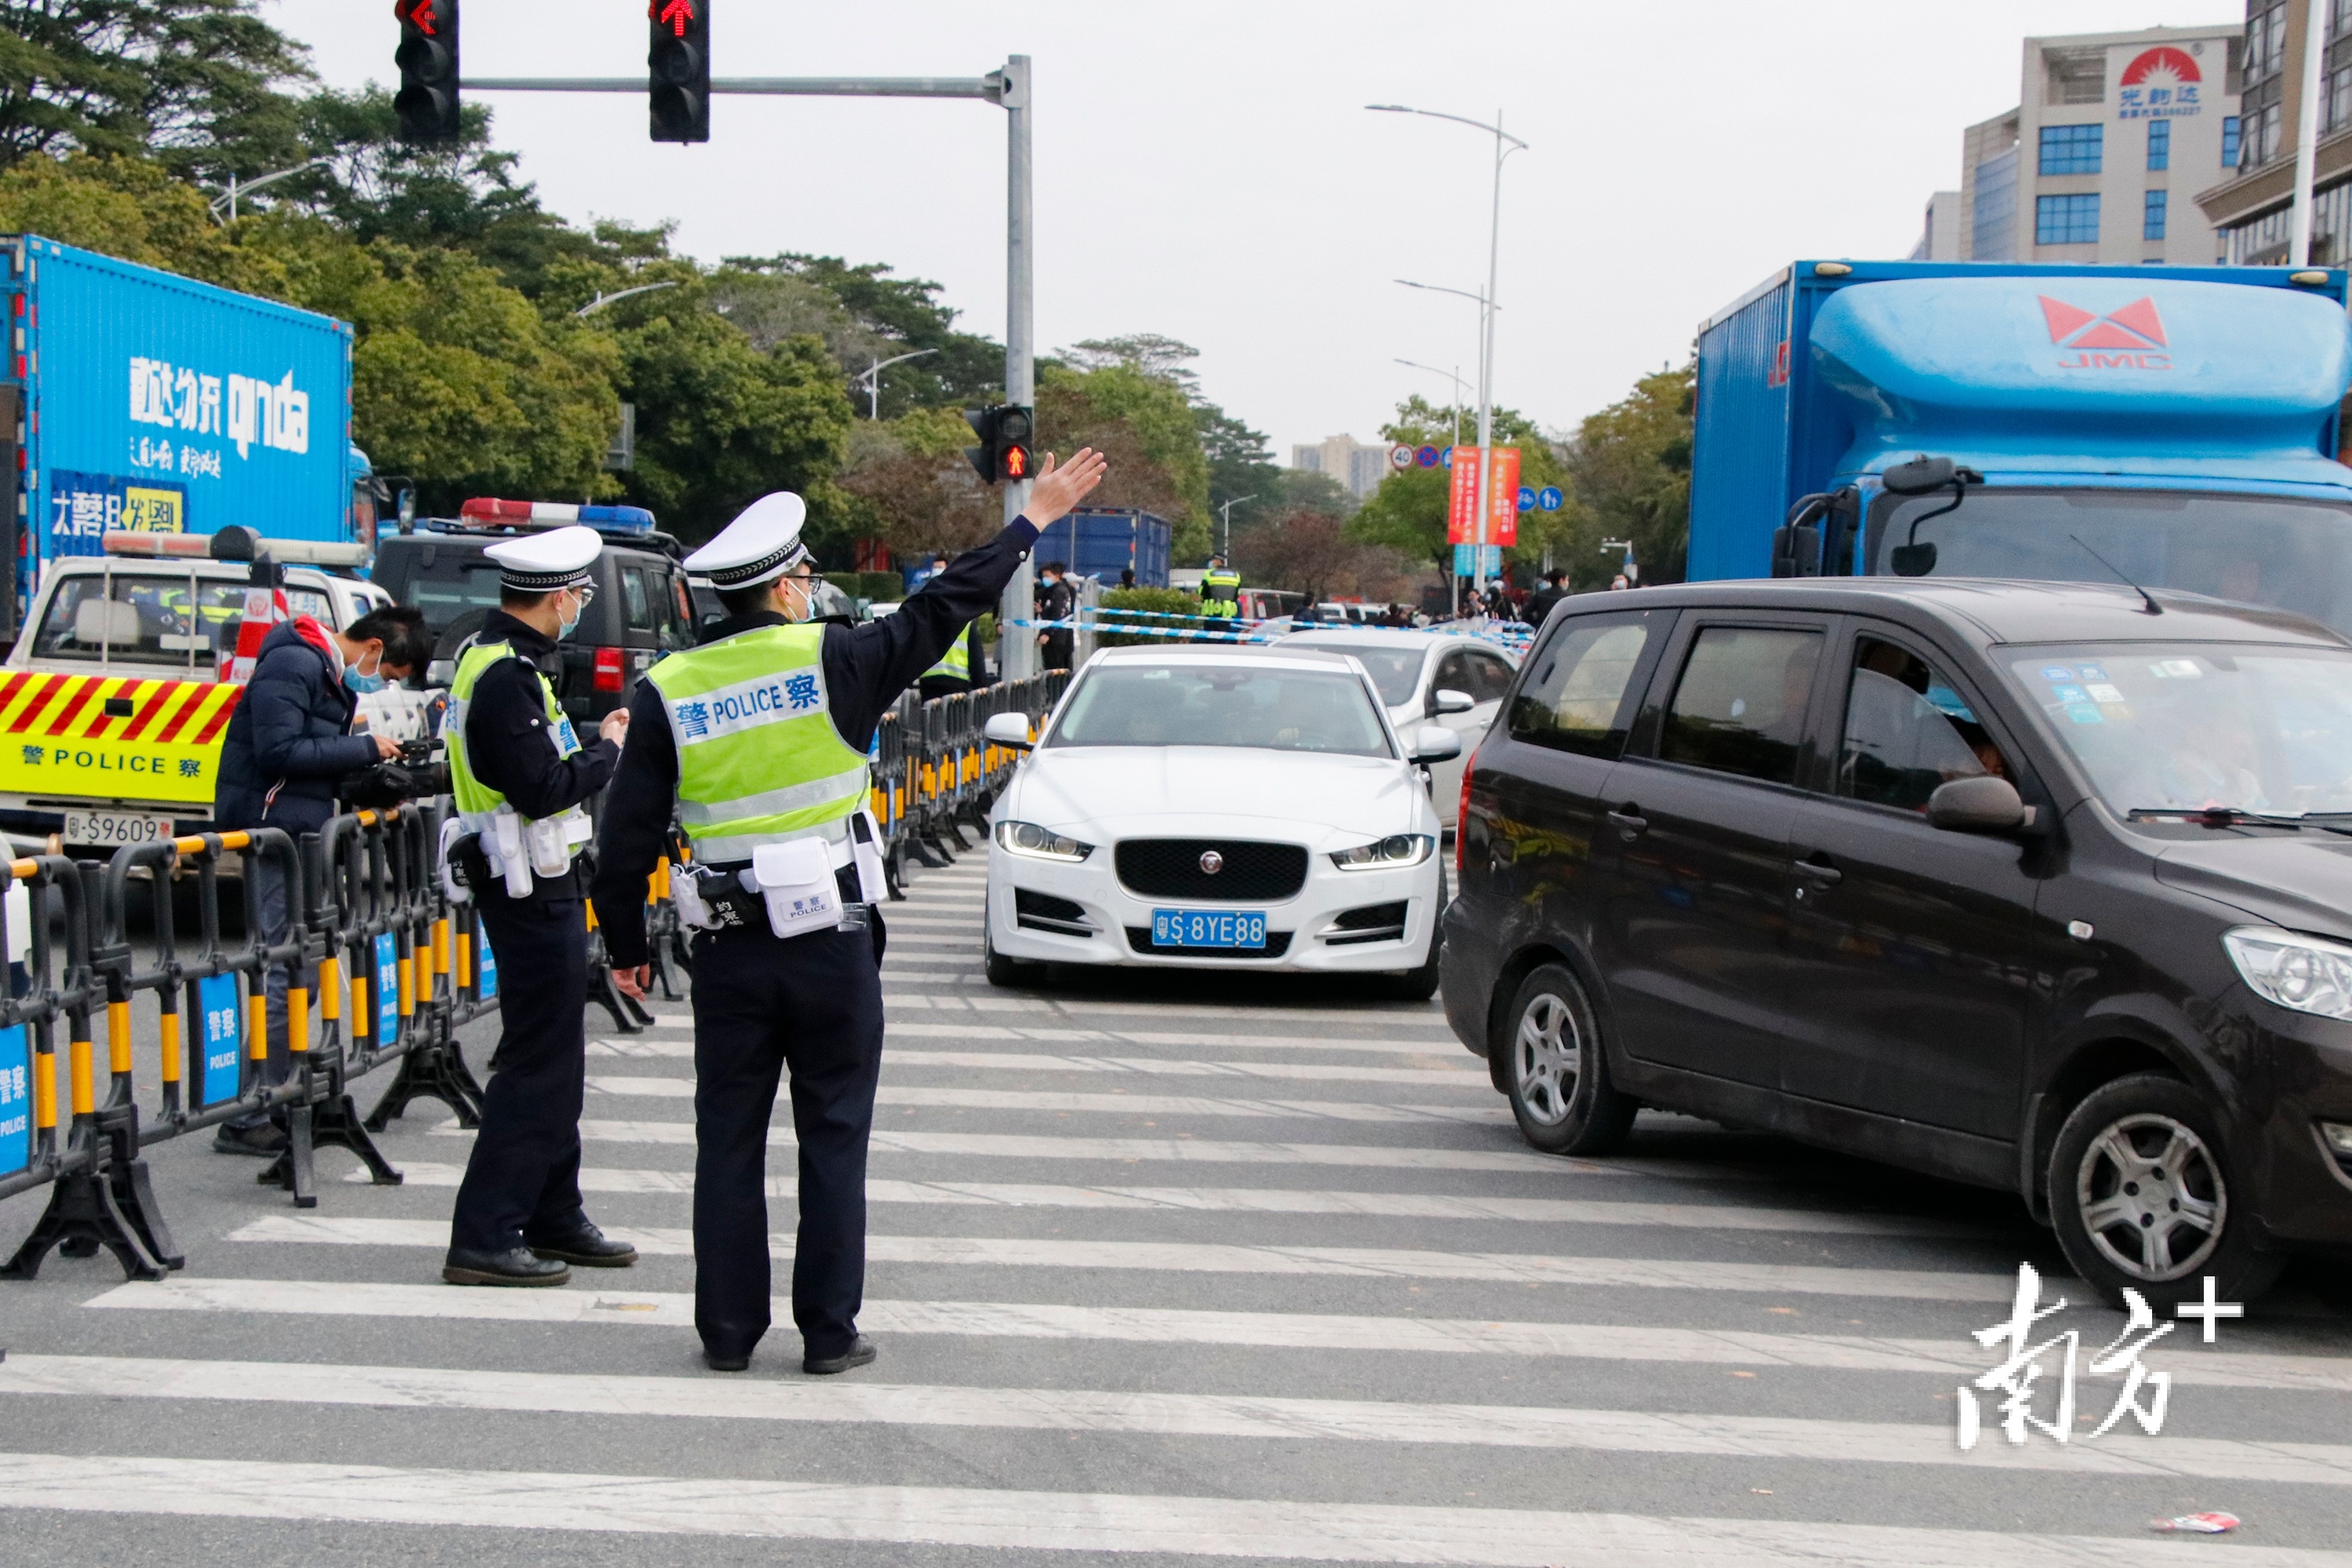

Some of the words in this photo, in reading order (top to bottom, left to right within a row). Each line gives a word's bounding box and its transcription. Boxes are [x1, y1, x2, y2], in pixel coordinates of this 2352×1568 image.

[2057, 353, 2175, 370] JMC
[1395, 451, 1410, 463] 40
[675, 702, 710, 739] 警
[712, 685, 784, 725] POLICE
[785, 673, 819, 710] 察
[22, 744, 45, 766] 警
[54, 749, 165, 774] POLICE
[179, 758, 201, 778] 察
[789, 903, 827, 918] POLICE
[381, 963, 397, 993] 警察
[208, 1007, 236, 1043] 警察
[209, 1050, 237, 1070] POLICE
[0, 1064, 26, 1105] 警察
[0, 1114, 26, 1138] POLICE
